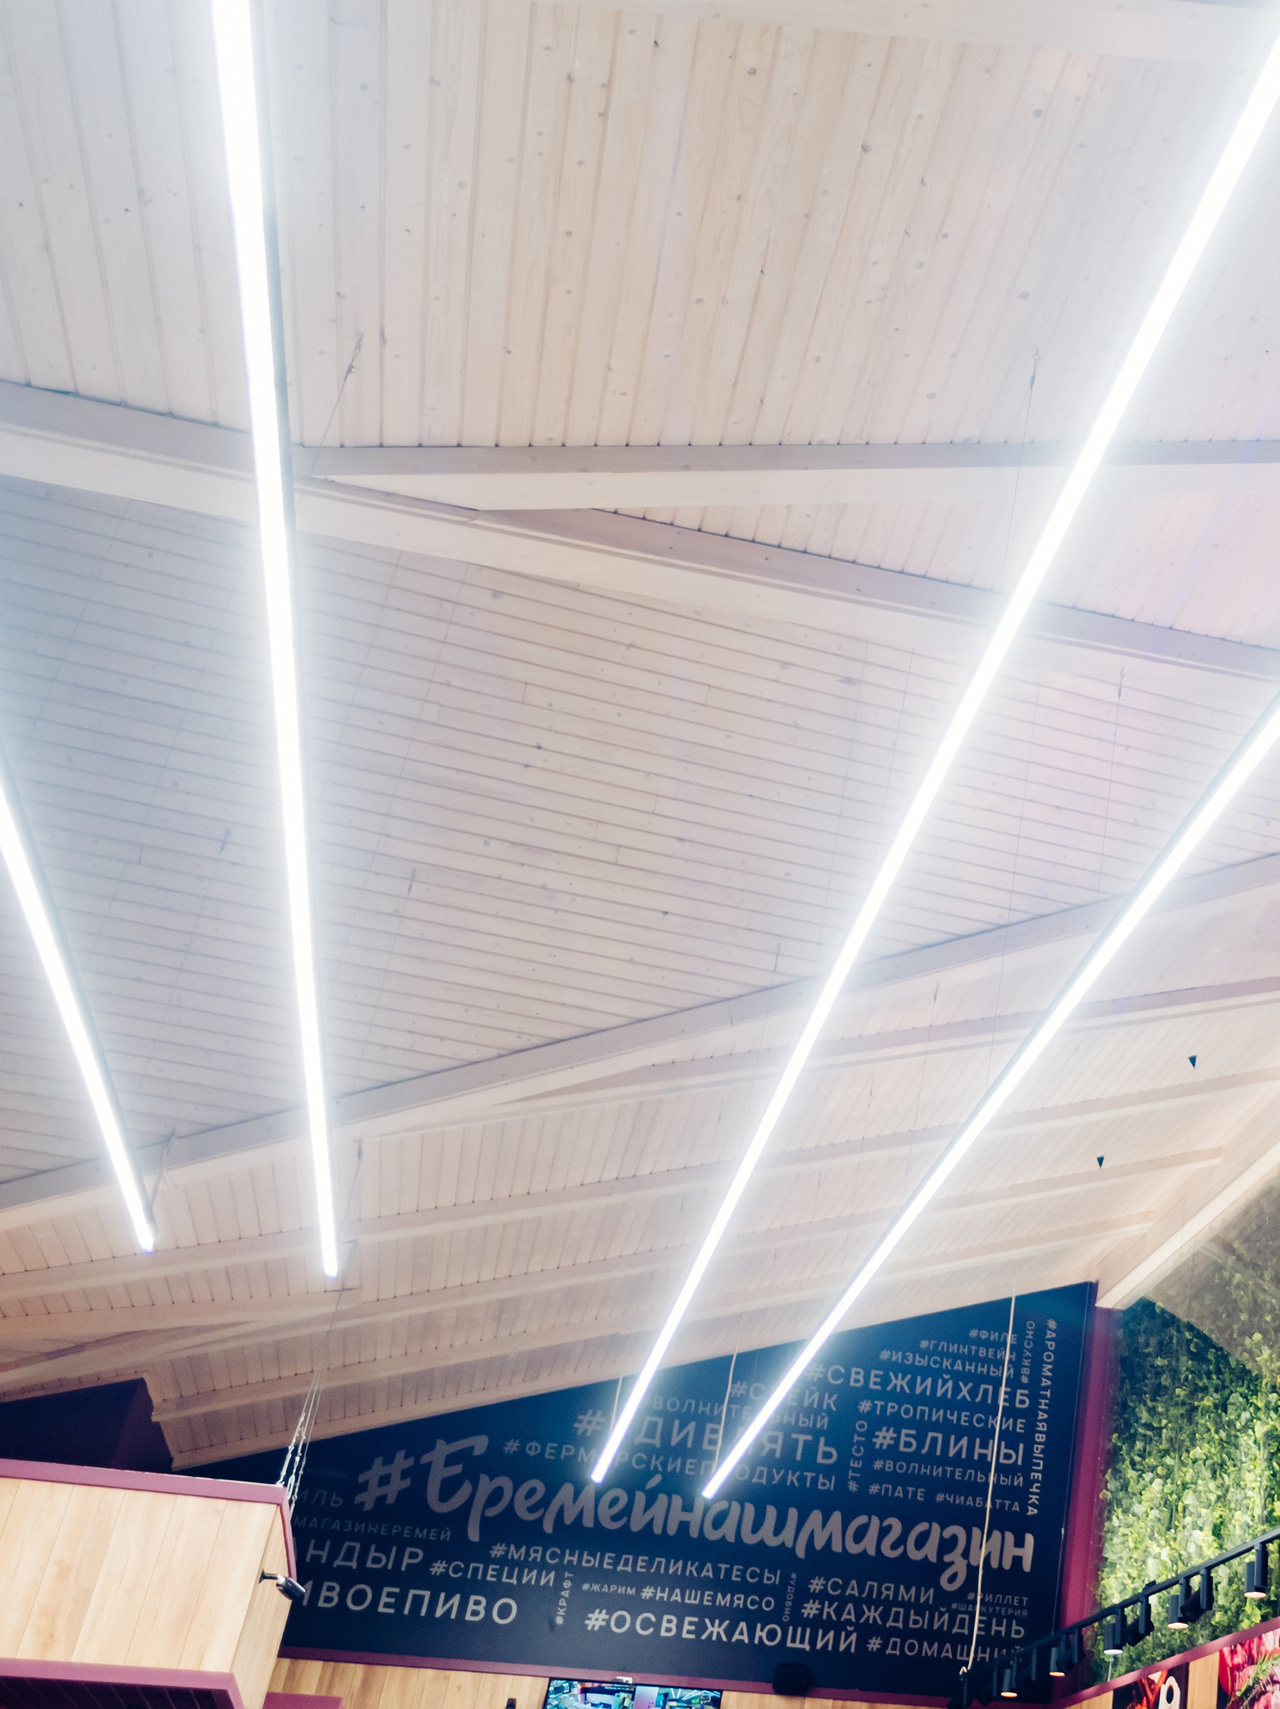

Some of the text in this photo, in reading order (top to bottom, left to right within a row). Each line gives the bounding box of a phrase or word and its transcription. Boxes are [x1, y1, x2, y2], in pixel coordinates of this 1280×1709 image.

[919, 1339, 1016, 1361] #ГЛИНТВЕЙН
[968, 1328, 1018, 1345] #ФИЛЕ
[1021, 1320, 1036, 1384] #ВКУСНО
[879, 1349, 1015, 1379] #ИЗЫСКАННЫЙ
[730, 1380, 839, 1412] #СЕЙК
[804, 1361, 1030, 1409] #СВЕЖИЙХЛЕБ
[858, 1399, 1027, 1433] #ТРОПИЧЕСКИЕ
[1026, 1318, 1058, 1516] #АРОМАТНАЯВЫПЕЧКА
[573, 1408, 839, 1465] #ДИВЯТЬ
[872, 1426, 1024, 1466] #БЛИНЫ
[502, 1438, 836, 1492] #ФЕРМРСКИЕПОДУКТЫ
[847, 1420, 868, 1493] #ТЕСТО
[868, 1483, 926, 1501] #ПАТЕ
[294, 1537, 424, 1572] НДЫР
[490, 1543, 781, 1586] #МЯСНЫЕДЕЛИКАТЕСЫ
[430, 1560, 556, 1587] #СПЕЦИИ
[582, 1582, 637, 1597] #ЖАРИМ
[808, 1576, 935, 1605] #САЛЯМИ
[555, 1571, 574, 1626] #КРАФТ
[640, 1585, 775, 1612] #НАШЕМЯСО
[951, 1602, 1028, 1618] #ШАКУТЕРИЯ
[584, 1608, 858, 1654] #ОСВЕЖАЮЩИЙ
[801, 1599, 1026, 1640] #КАЖДЫЙДЕНЬ
